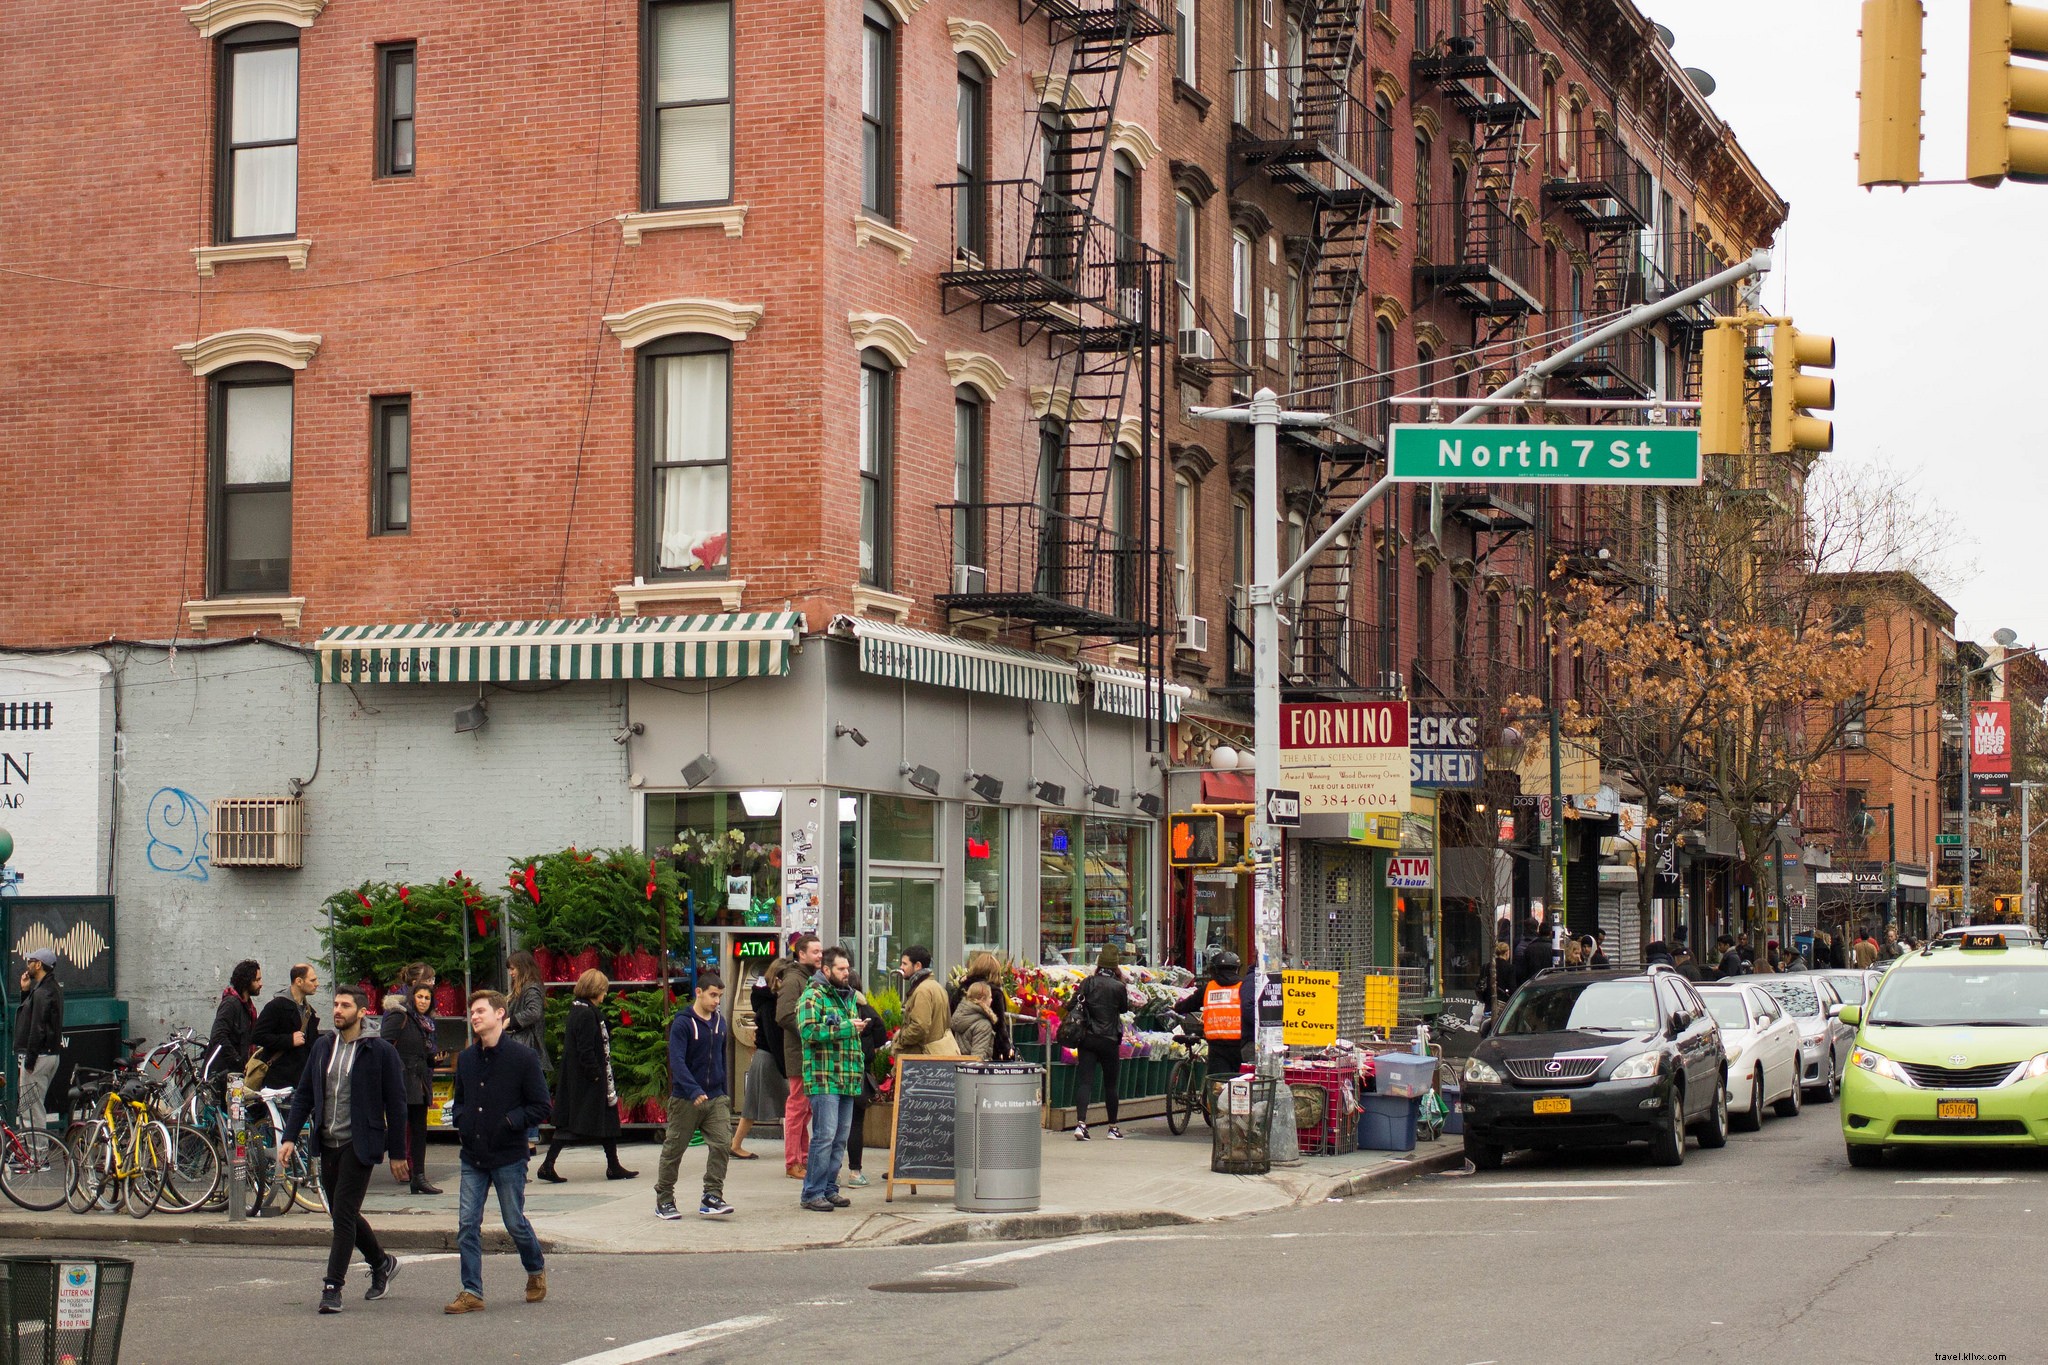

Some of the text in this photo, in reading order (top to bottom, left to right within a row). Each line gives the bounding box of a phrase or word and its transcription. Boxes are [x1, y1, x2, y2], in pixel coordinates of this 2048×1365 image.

[1438, 439, 1651, 468] North 7 St
[360, 656, 410, 673] Bedford
[1291, 707, 1392, 745] FORNINO
[1410, 716, 1477, 745] ECKS
[1283, 754, 1299, 762] THE
[1302, 753, 1317, 762] ART
[1328, 752, 1364, 761] SCIENCE
[1366, 752, 1377, 760] OF
[1380, 752, 1402, 760] PIZZA
[1410, 753, 1477, 781] SHED
[1284, 770, 1400, 780] Award Winning Wood Burning Oven
[1304, 793, 1397, 806] 8 384-6004
[1514, 797, 1534, 806] DOS
[1271, 801, 1296, 815] ONE WAY
[1387, 859, 1429, 876] ATM
[1391, 877, 1402, 886] 24
[1972, 937, 1994, 946] AC217
[739, 941, 771, 957] ATM
[1282, 975, 1331, 986] ell Phone
[1287, 988, 1316, 998] Cases
[1297, 1007, 1306, 1016] &
[1282, 1020, 1299, 1028] let
[1301, 1020, 1335, 1030] Covers
[60, 1289, 78, 1297] LITTER
[59, 1320, 74, 1328] $100
